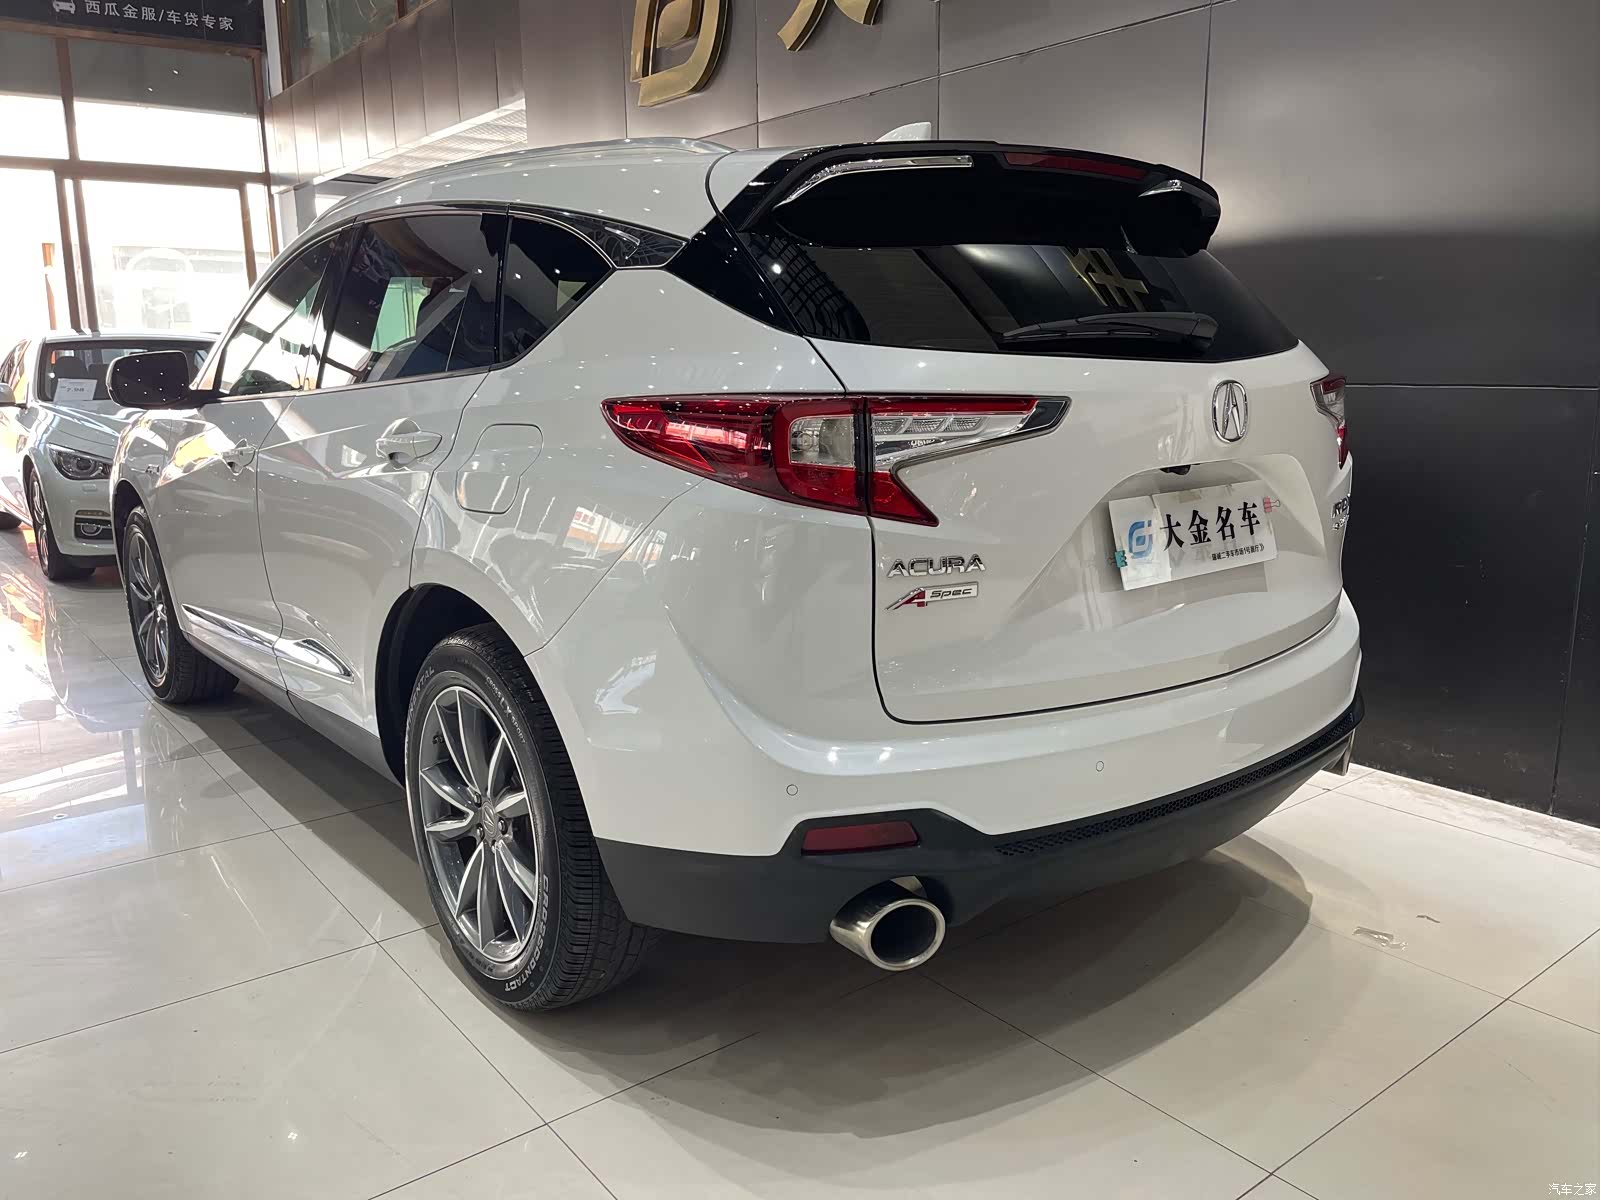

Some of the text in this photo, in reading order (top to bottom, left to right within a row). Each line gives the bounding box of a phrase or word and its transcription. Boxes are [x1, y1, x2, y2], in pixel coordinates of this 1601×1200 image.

[85, 0, 234, 31] 西瓜金服/车贷专家
[1160, 501, 1262, 551] 大金名车
[887, 554, 986, 578] ACURA
[930, 588, 973, 599] Spec
